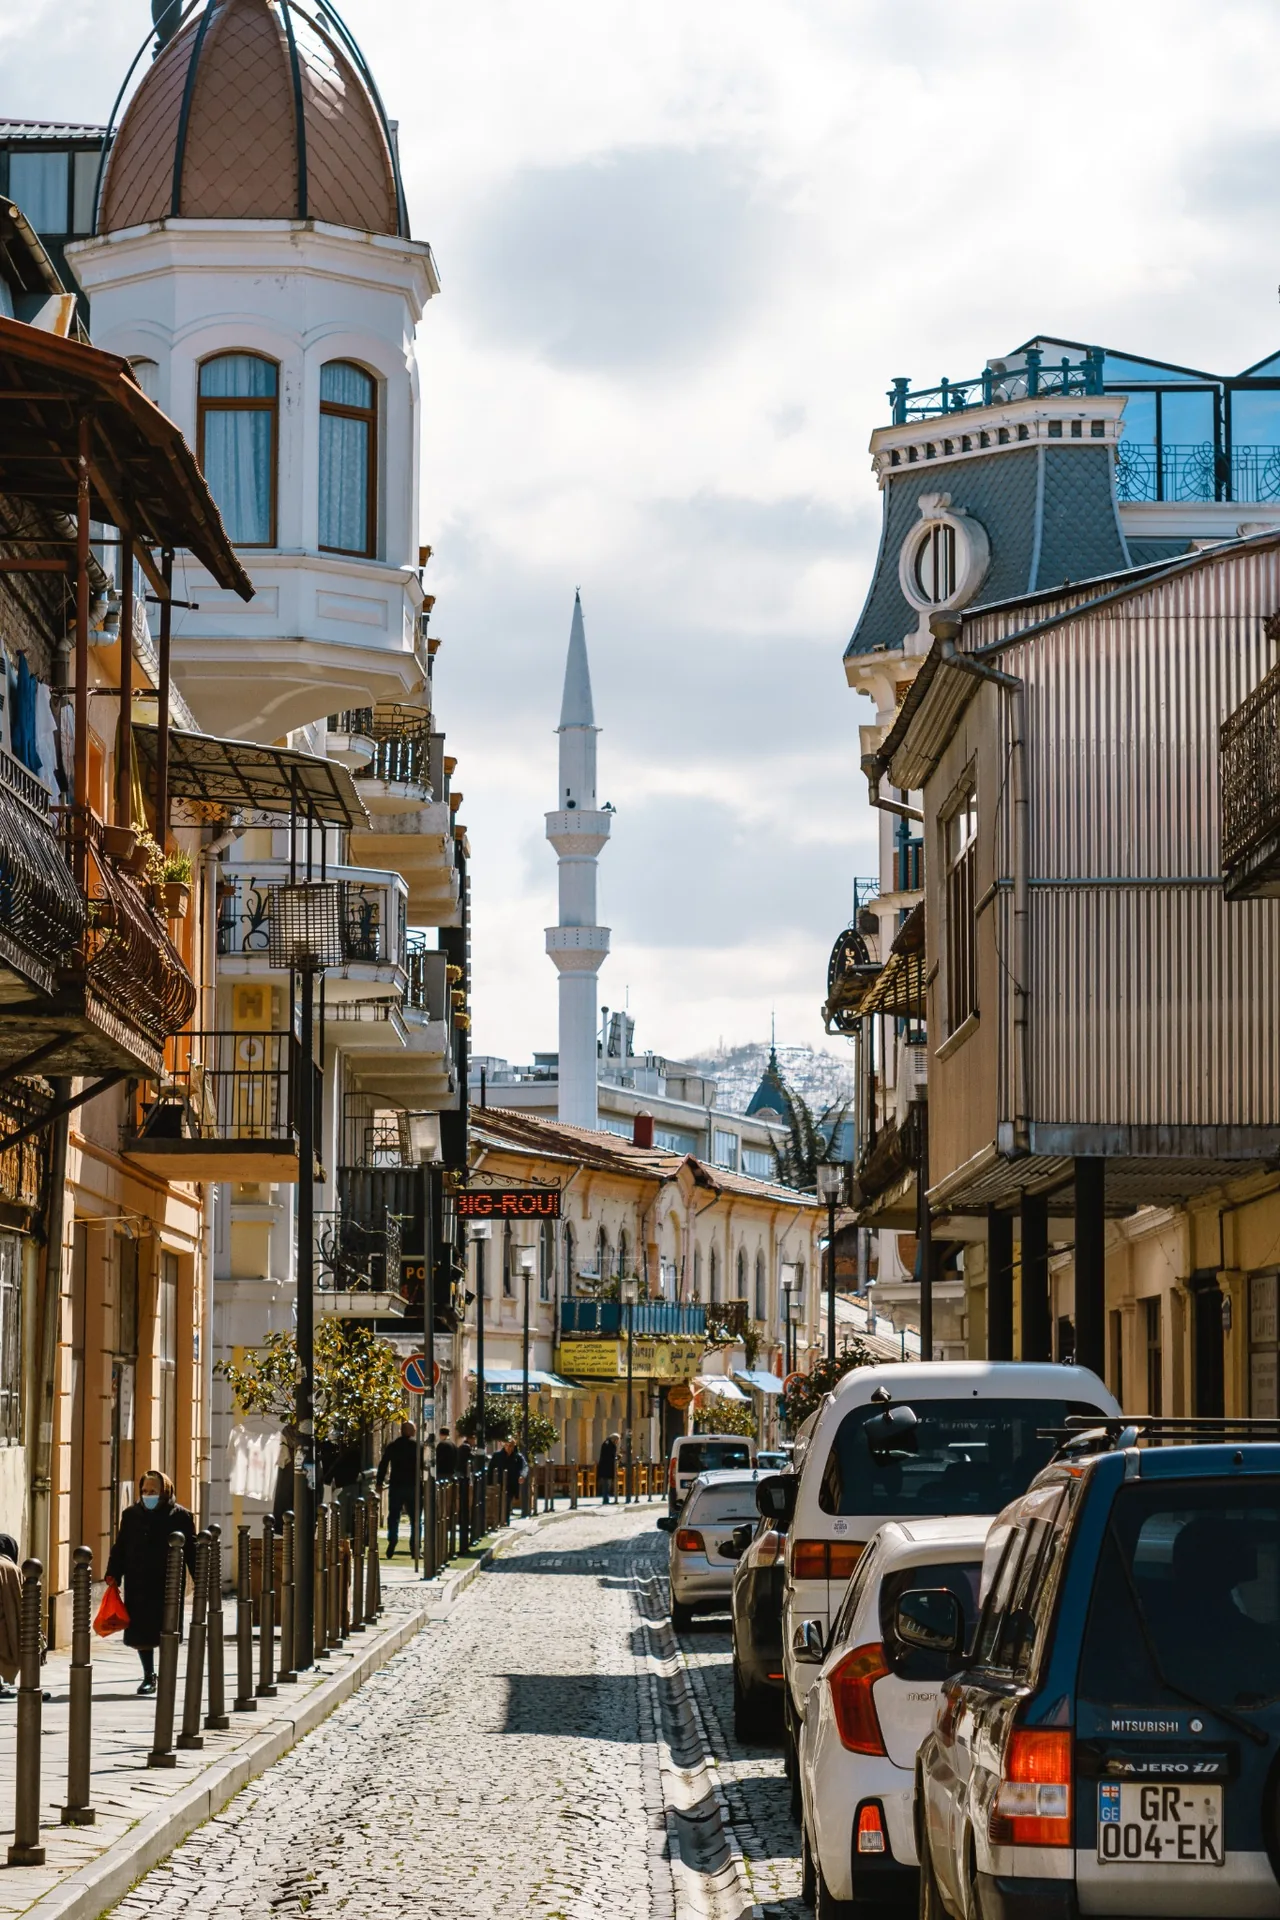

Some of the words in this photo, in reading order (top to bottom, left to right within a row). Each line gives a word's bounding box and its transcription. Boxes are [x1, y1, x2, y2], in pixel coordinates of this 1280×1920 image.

[458, 1194, 557, 1214] BIG-ROU
[1111, 1720, 1179, 1733] MITSUBISHI
[1117, 1763, 1189, 1773] AJERO
[1101, 1807, 1119, 1821] GE
[1102, 1823, 1218, 1860] 004-EK
